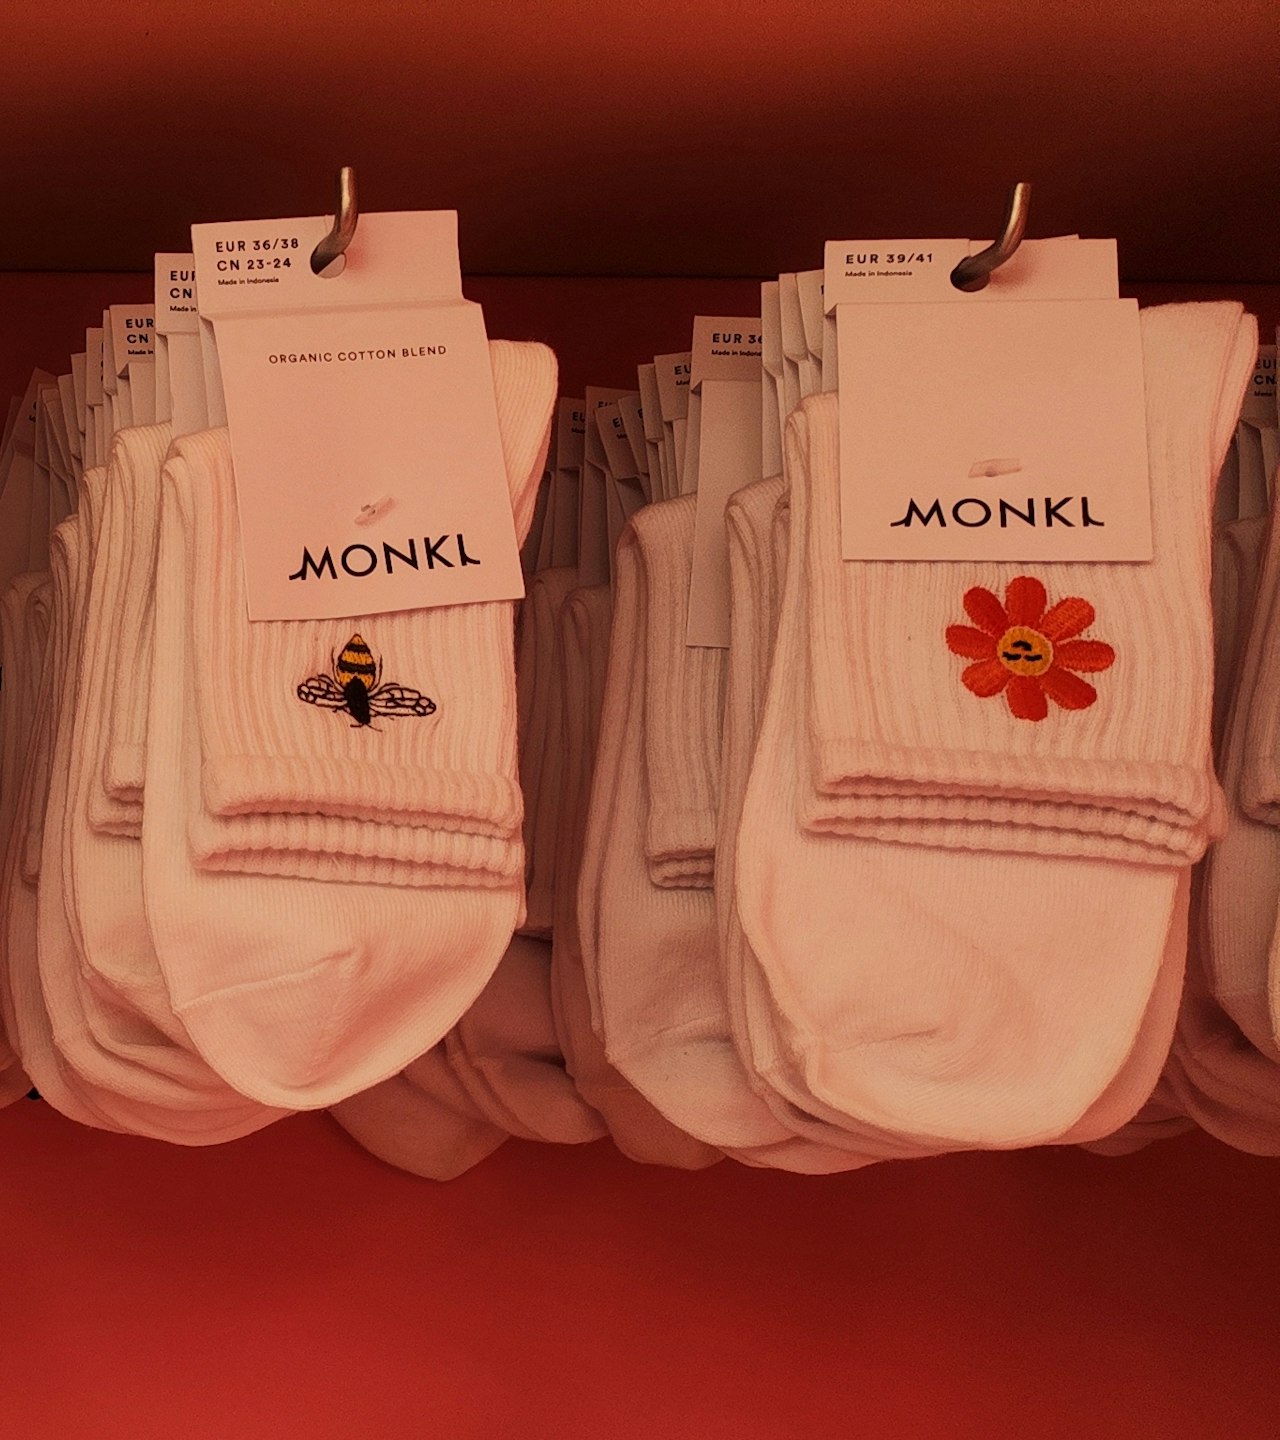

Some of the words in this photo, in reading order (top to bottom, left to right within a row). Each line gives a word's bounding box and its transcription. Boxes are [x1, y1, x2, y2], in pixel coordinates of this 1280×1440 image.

[216, 241, 246, 253] EUR
[253, 238, 299, 251] 36/38
[217, 260, 240, 271] CN
[247, 257, 292, 270] 23-24
[846, 254, 879, 264] EUR
[886, 253, 933, 263] 39/41
[170, 288, 192, 299] CN
[126, 319, 154, 328] EUR
[126, 334, 149, 344] CN
[712, 333, 742, 344] EUR
[268, 351, 333, 364] ORGANIC
[338, 349, 397, 362] COTTON
[401, 345, 447, 358] BLEND
